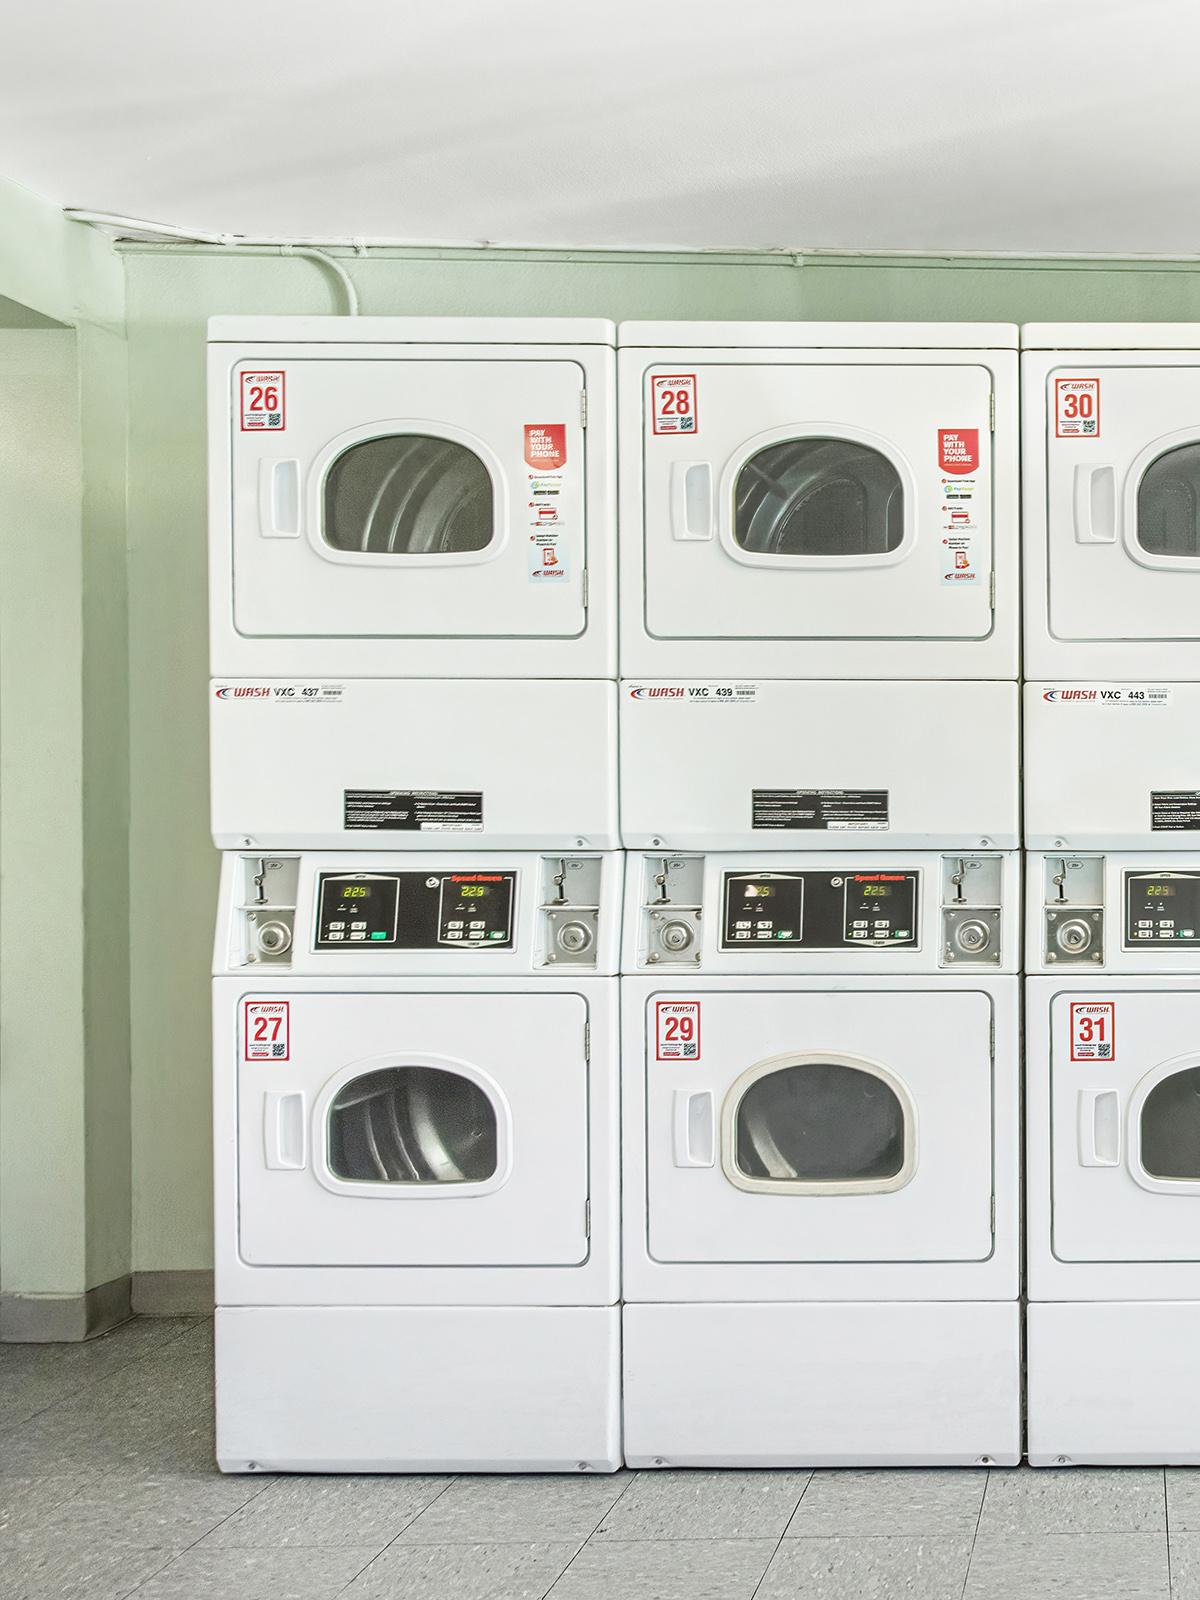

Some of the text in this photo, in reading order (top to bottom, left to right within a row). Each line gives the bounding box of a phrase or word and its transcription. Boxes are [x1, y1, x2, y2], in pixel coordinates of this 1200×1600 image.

[250, 386, 278, 411] 26
[661, 390, 689, 415] 28
[1064, 393, 1093, 418] 30
[234, 688, 319, 697] WASH VXC 437
[648, 688, 733, 697] WASH VXC 439
[1061, 690, 1145, 700] WASH VXC 443
[864, 886, 885, 896] 225
[254, 1017, 282, 1041] 27
[665, 1017, 693, 1041] 29
[1079, 1017, 1105, 1041] 31
